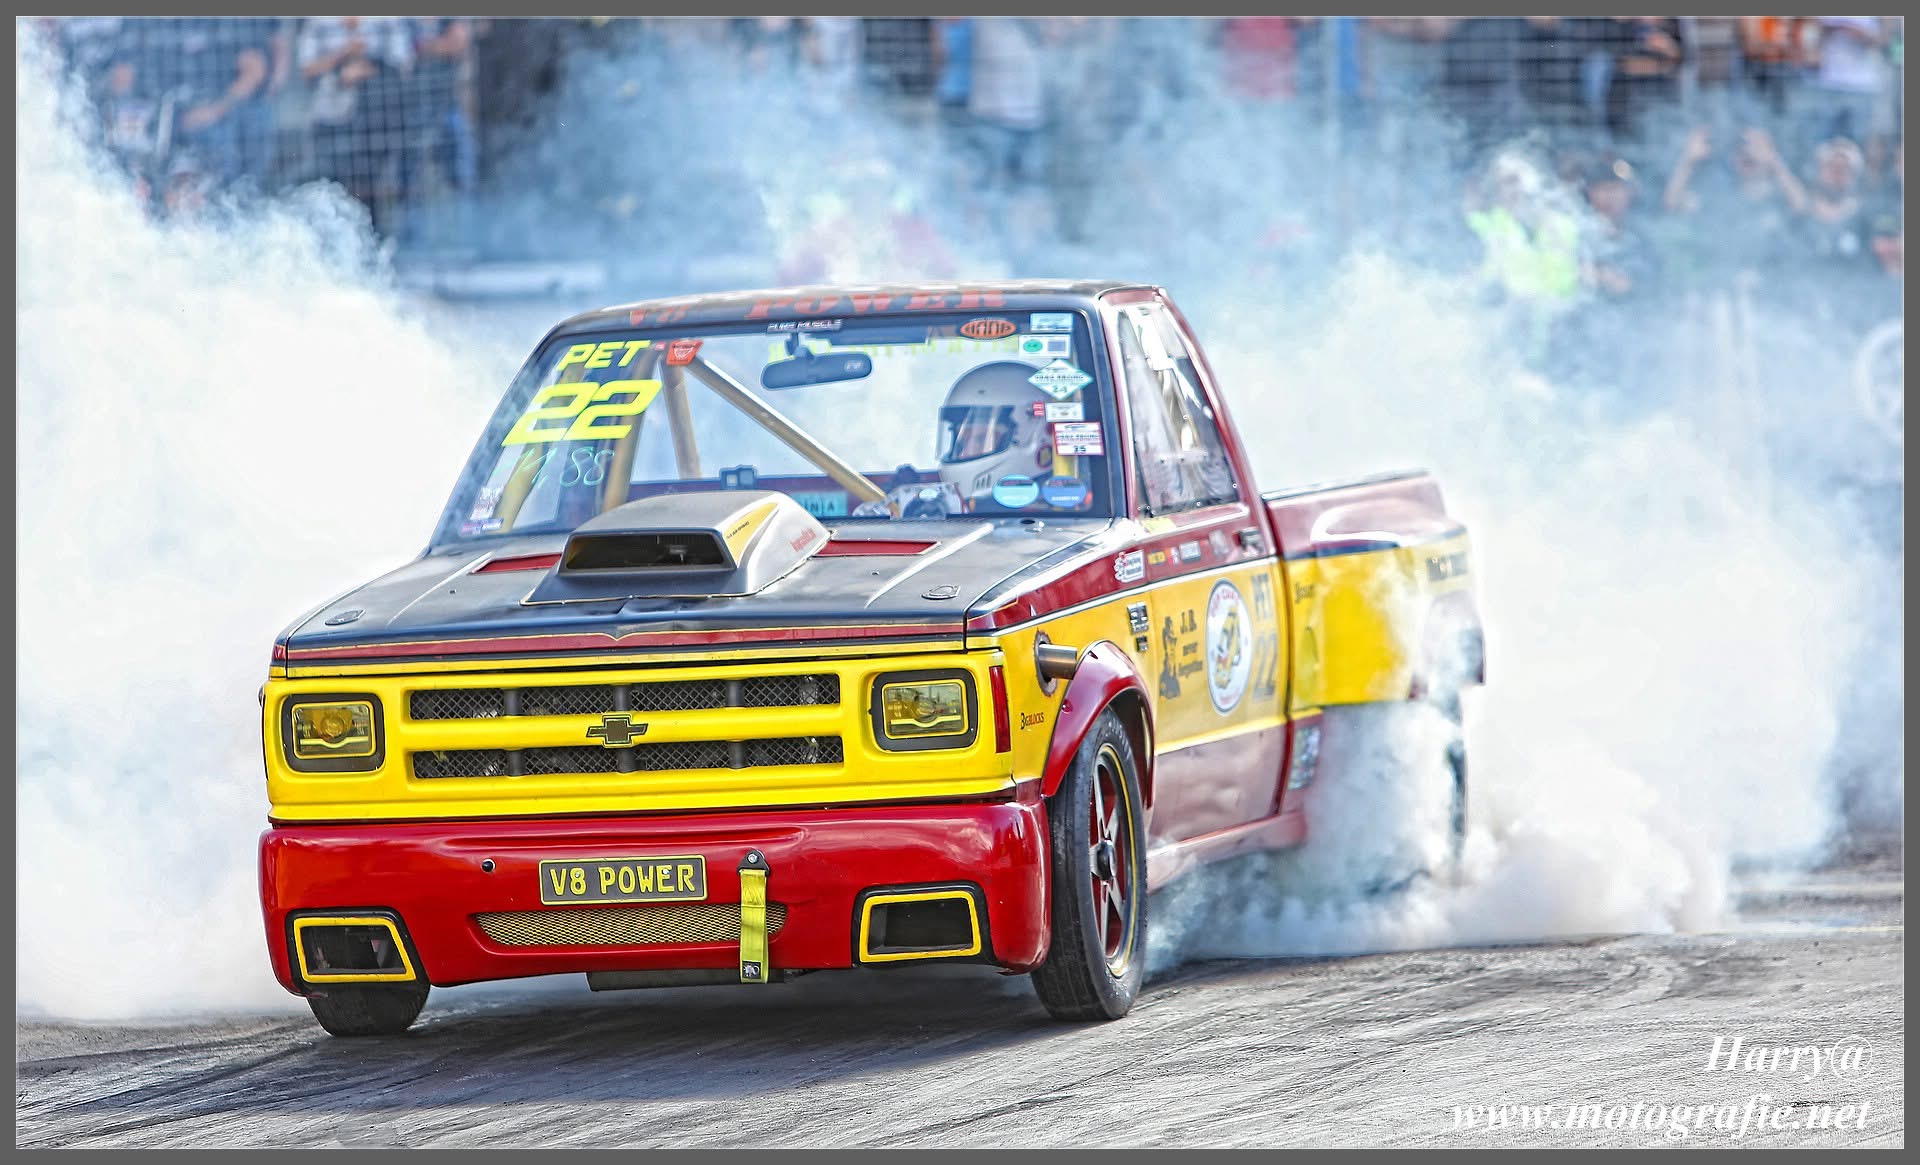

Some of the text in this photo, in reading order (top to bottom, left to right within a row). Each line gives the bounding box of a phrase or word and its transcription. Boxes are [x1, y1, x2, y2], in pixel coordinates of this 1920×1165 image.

[556, 339, 652, 372] PET
[501, 379, 663, 447] 22
[549, 863, 697, 897] V8 POWER
